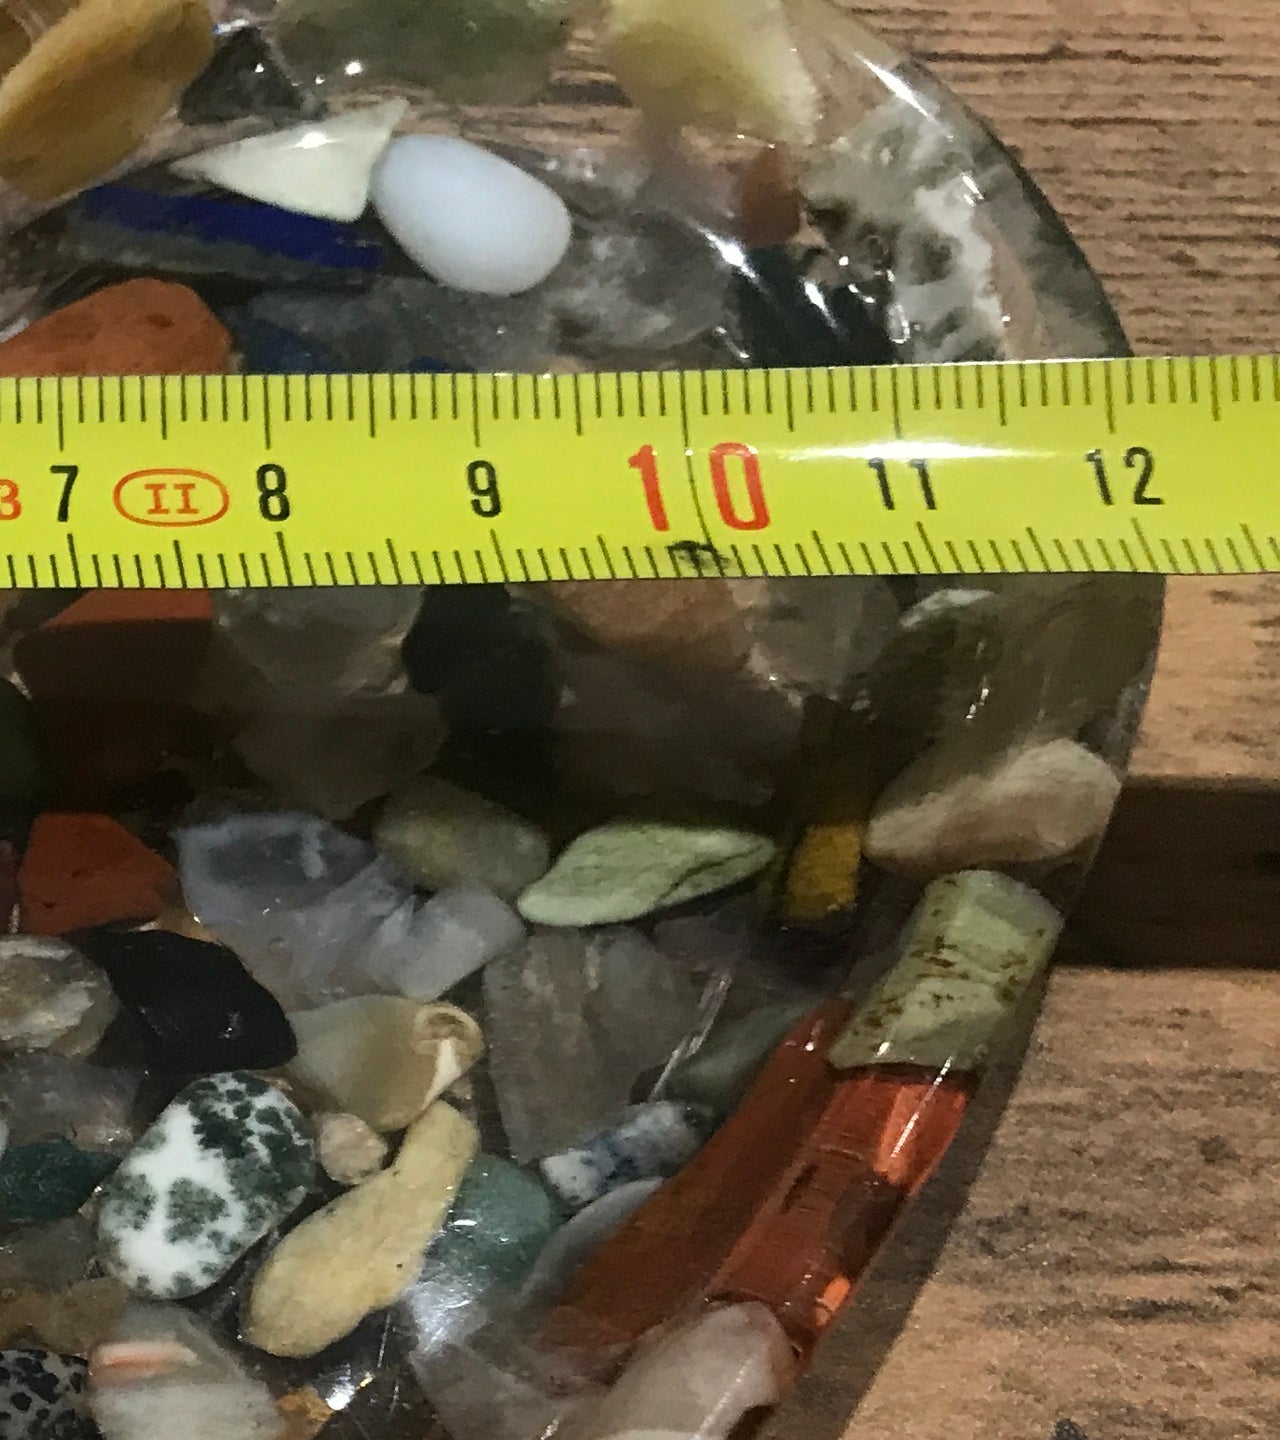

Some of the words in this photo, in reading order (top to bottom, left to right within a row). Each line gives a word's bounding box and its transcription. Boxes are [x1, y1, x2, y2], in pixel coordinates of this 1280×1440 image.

[50, 465, 80, 523] 7
[261, 464, 291, 521] 8
[467, 460, 500, 517] 9
[628, 442, 770, 532] 10
[867, 456, 937, 510] 11
[1085, 447, 1163, 506] 12
